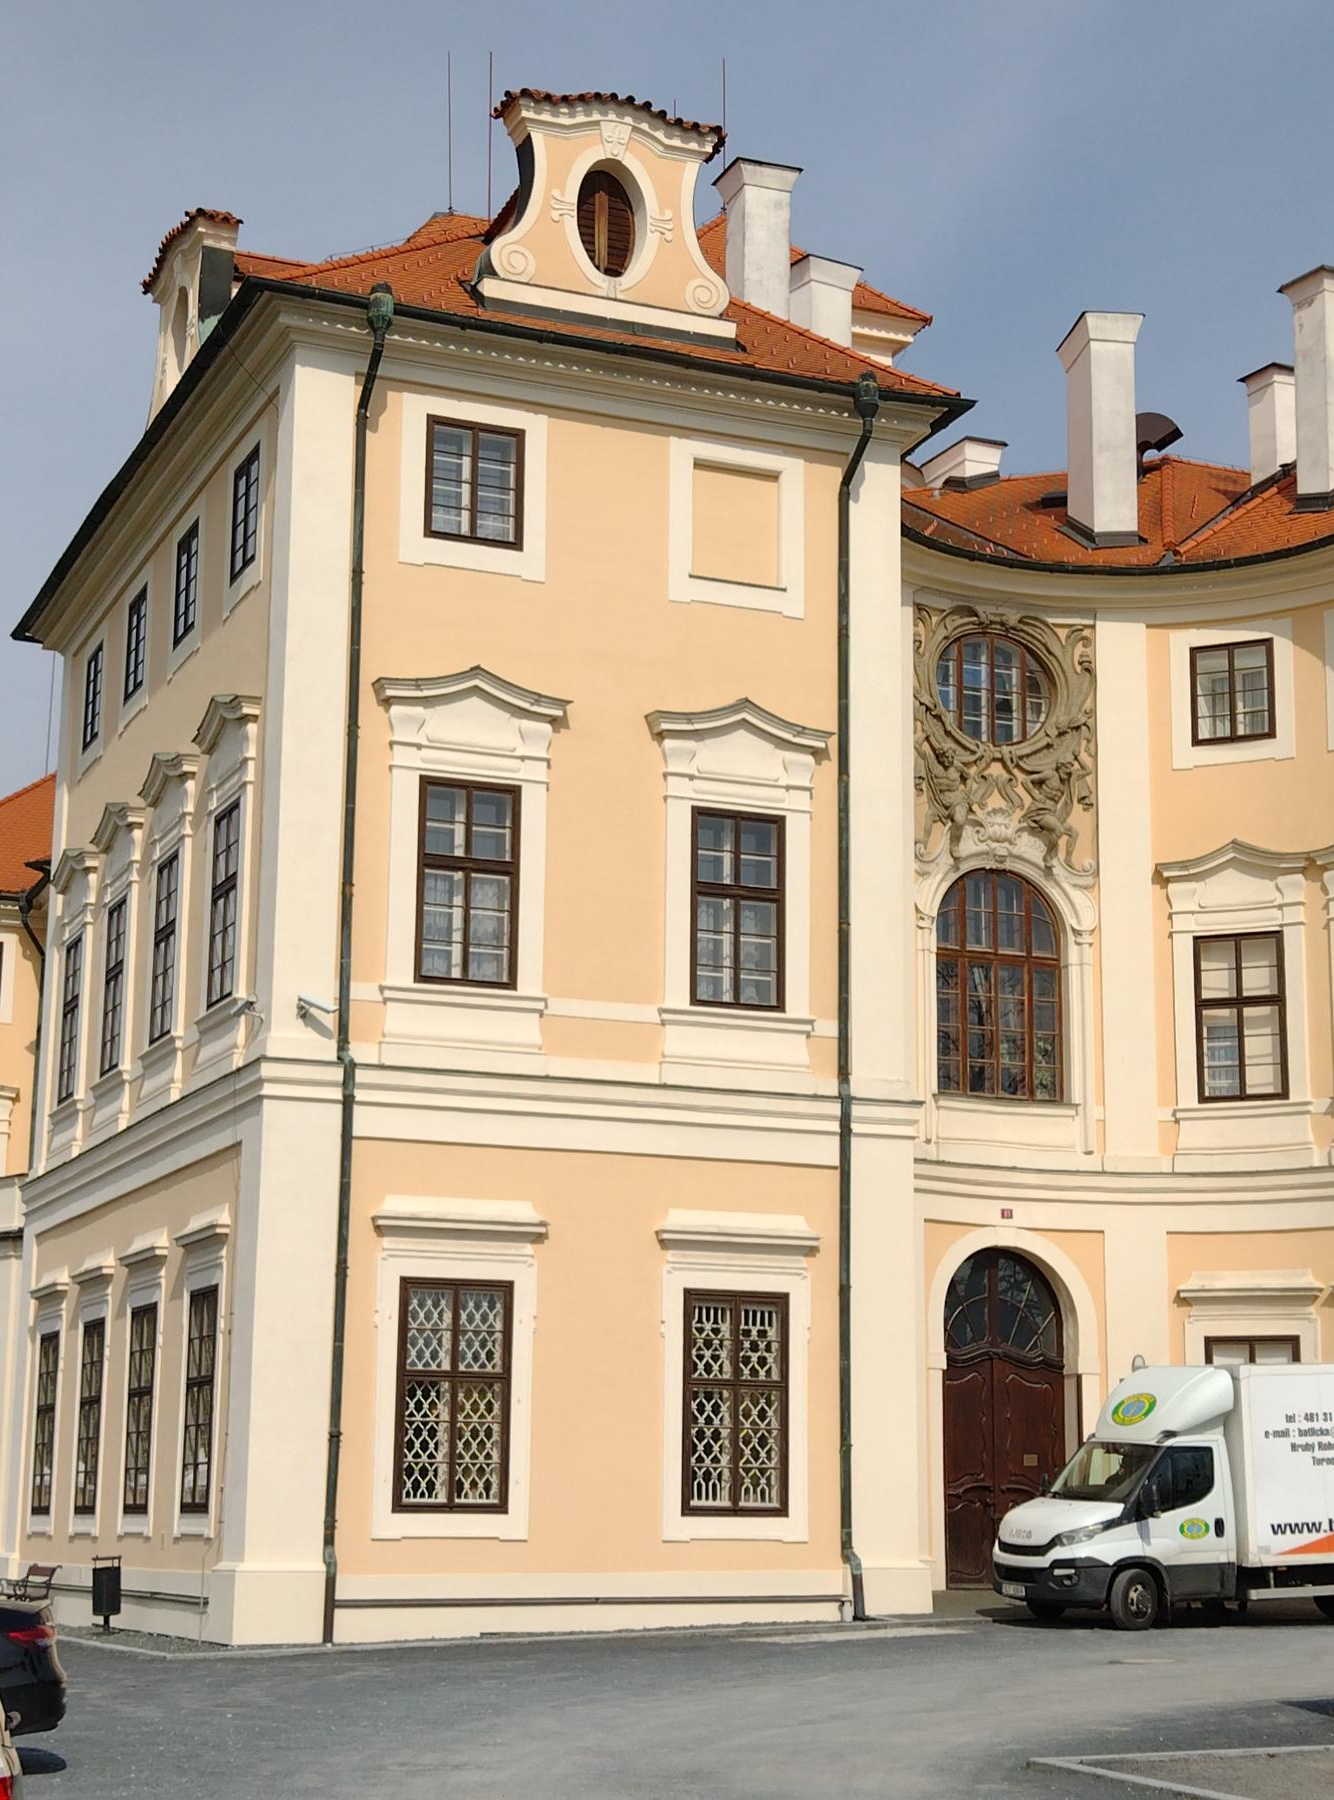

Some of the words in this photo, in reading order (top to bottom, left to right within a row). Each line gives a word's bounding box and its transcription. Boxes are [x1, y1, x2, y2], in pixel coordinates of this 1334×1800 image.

[1285, 1413, 1296, 1423] tel
[1303, 1412, 1319, 1423] 481
[1323, 1412, 1333, 1422] 31
[1264, 1428, 1290, 1438] e-mail
[1291, 1441, 1315, 1453] Hrubý
